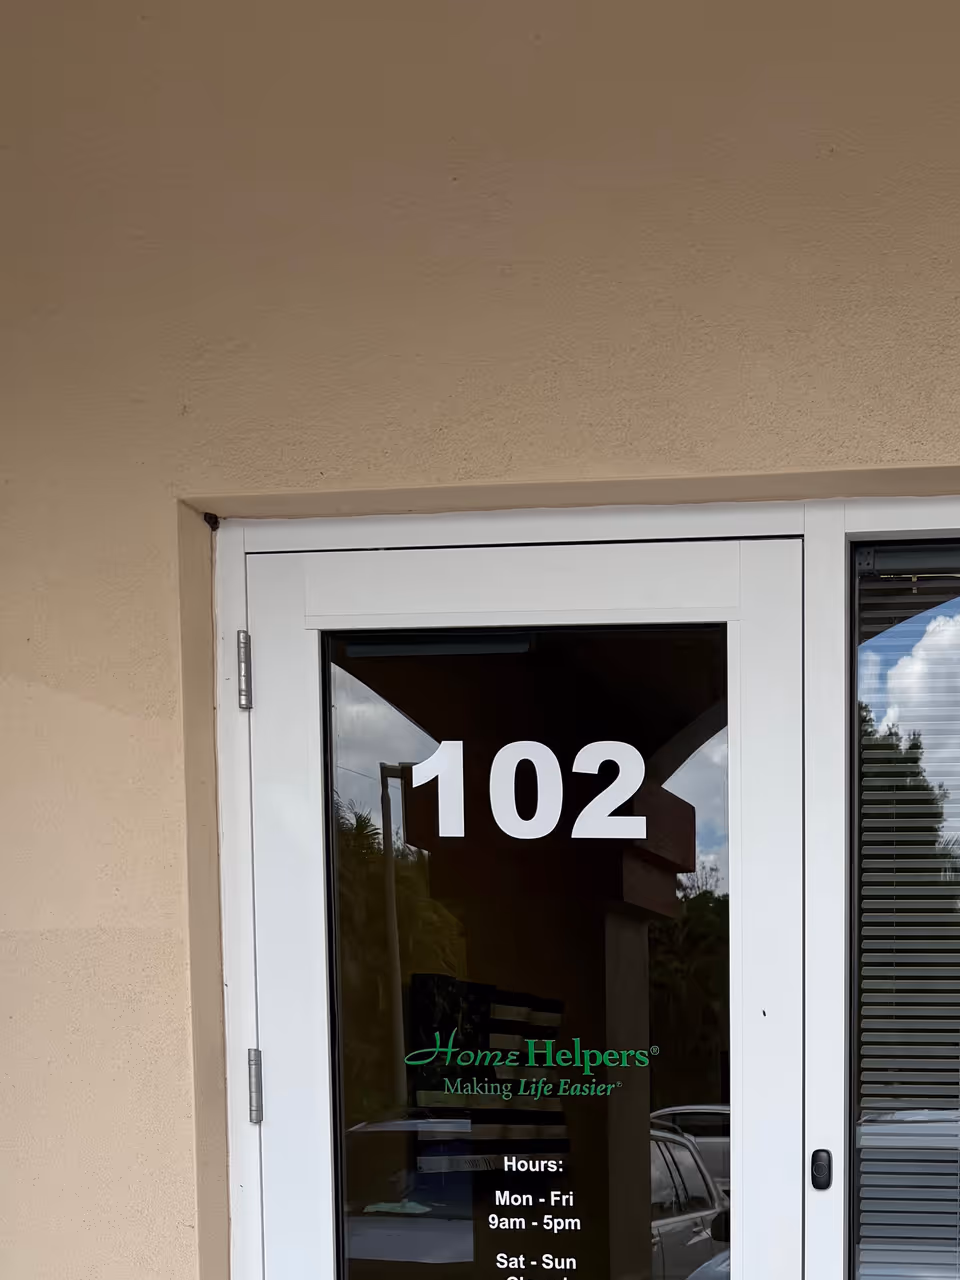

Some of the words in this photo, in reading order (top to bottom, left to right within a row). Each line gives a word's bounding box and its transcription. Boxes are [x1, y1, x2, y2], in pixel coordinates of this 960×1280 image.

[412, 740, 648, 840] 102
[403, 1027, 520, 1067] Home
[444, 1077, 512, 1101] Making
[518, 1078, 553, 1101] Life
[503, 1156, 564, 1172] Hours:
[495, 1190, 533, 1206] Mon
[550, 1191, 575, 1207] Fri
[488, 1214, 526, 1230] 9am
[542, 1215, 581, 1234] 5pm
[496, 1253, 526, 1269] Sat
[541, 1253, 577, 1270] Sun
